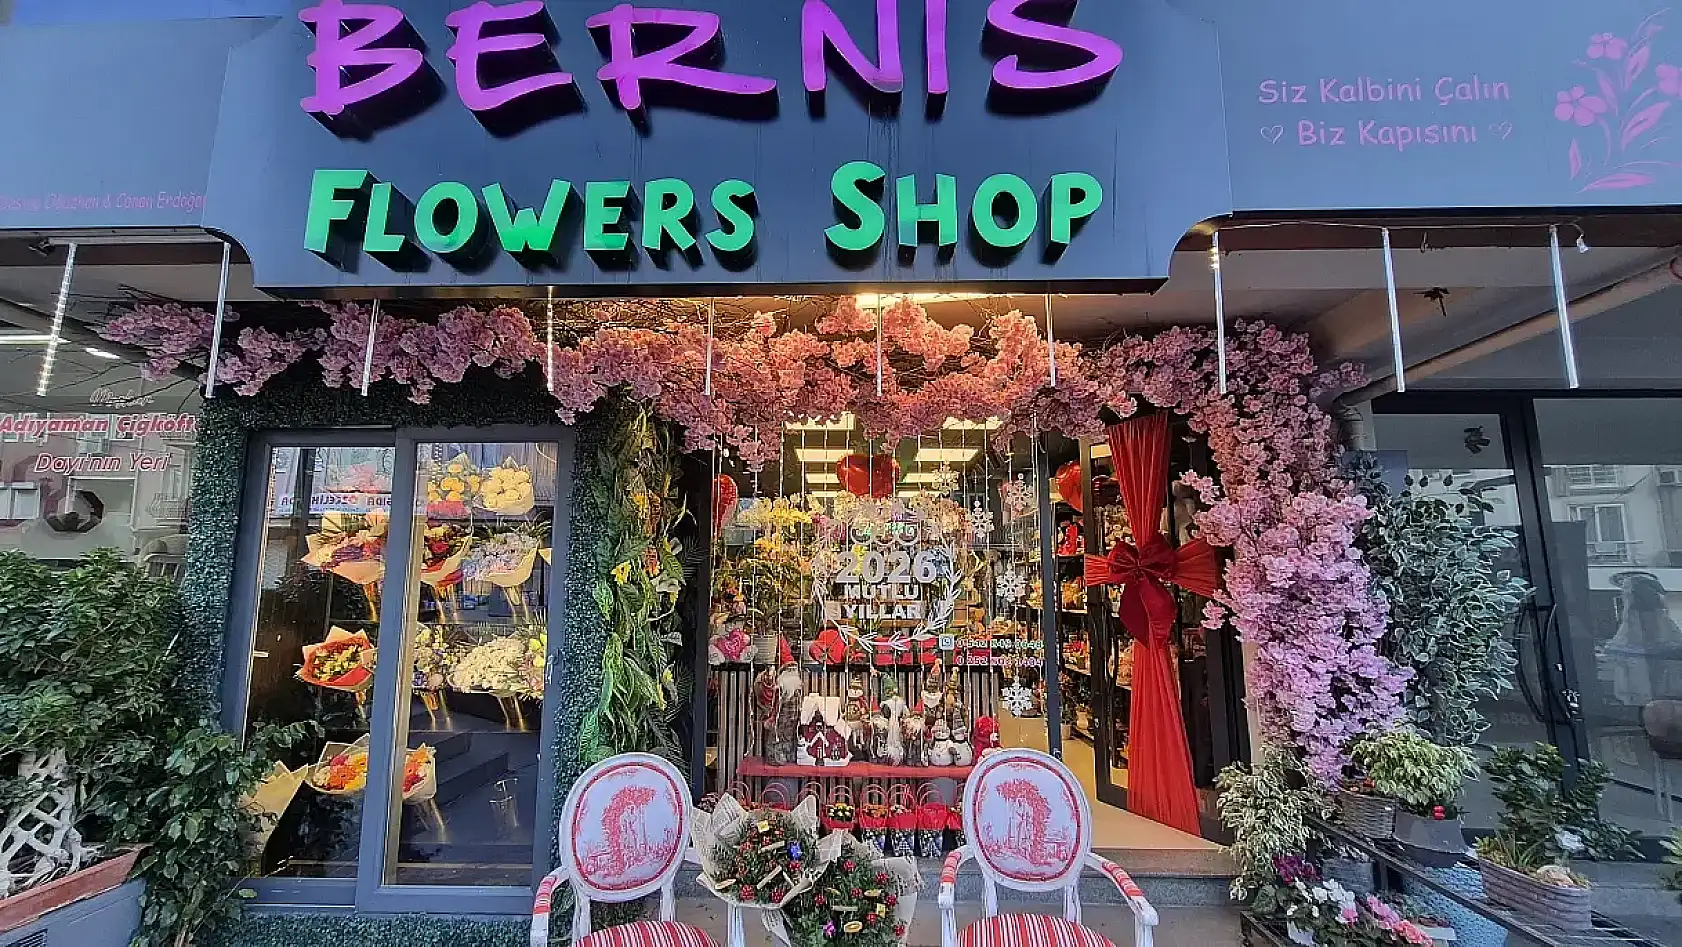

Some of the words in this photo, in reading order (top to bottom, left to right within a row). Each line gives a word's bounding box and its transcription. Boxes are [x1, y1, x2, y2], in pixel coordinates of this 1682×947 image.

[299, 0, 1124, 116] BERNIS
[1258, 79, 1308, 104] Siz
[1319, 76, 1423, 103] Kalbini
[1434, 73, 1511, 106] Çalın
[1297, 119, 1347, 146] Biz
[1358, 118, 1479, 152] Kapısını
[304, 167, 756, 254] FLOWERS
[824, 160, 1104, 252] SHOP
[0, 414, 110, 436] Adıyaman
[129, 452, 172, 472] Yeri
[835, 550, 937, 584] 2026
[843, 584, 919, 600] MUTLU
[843, 603, 922, 620] YILLAR
